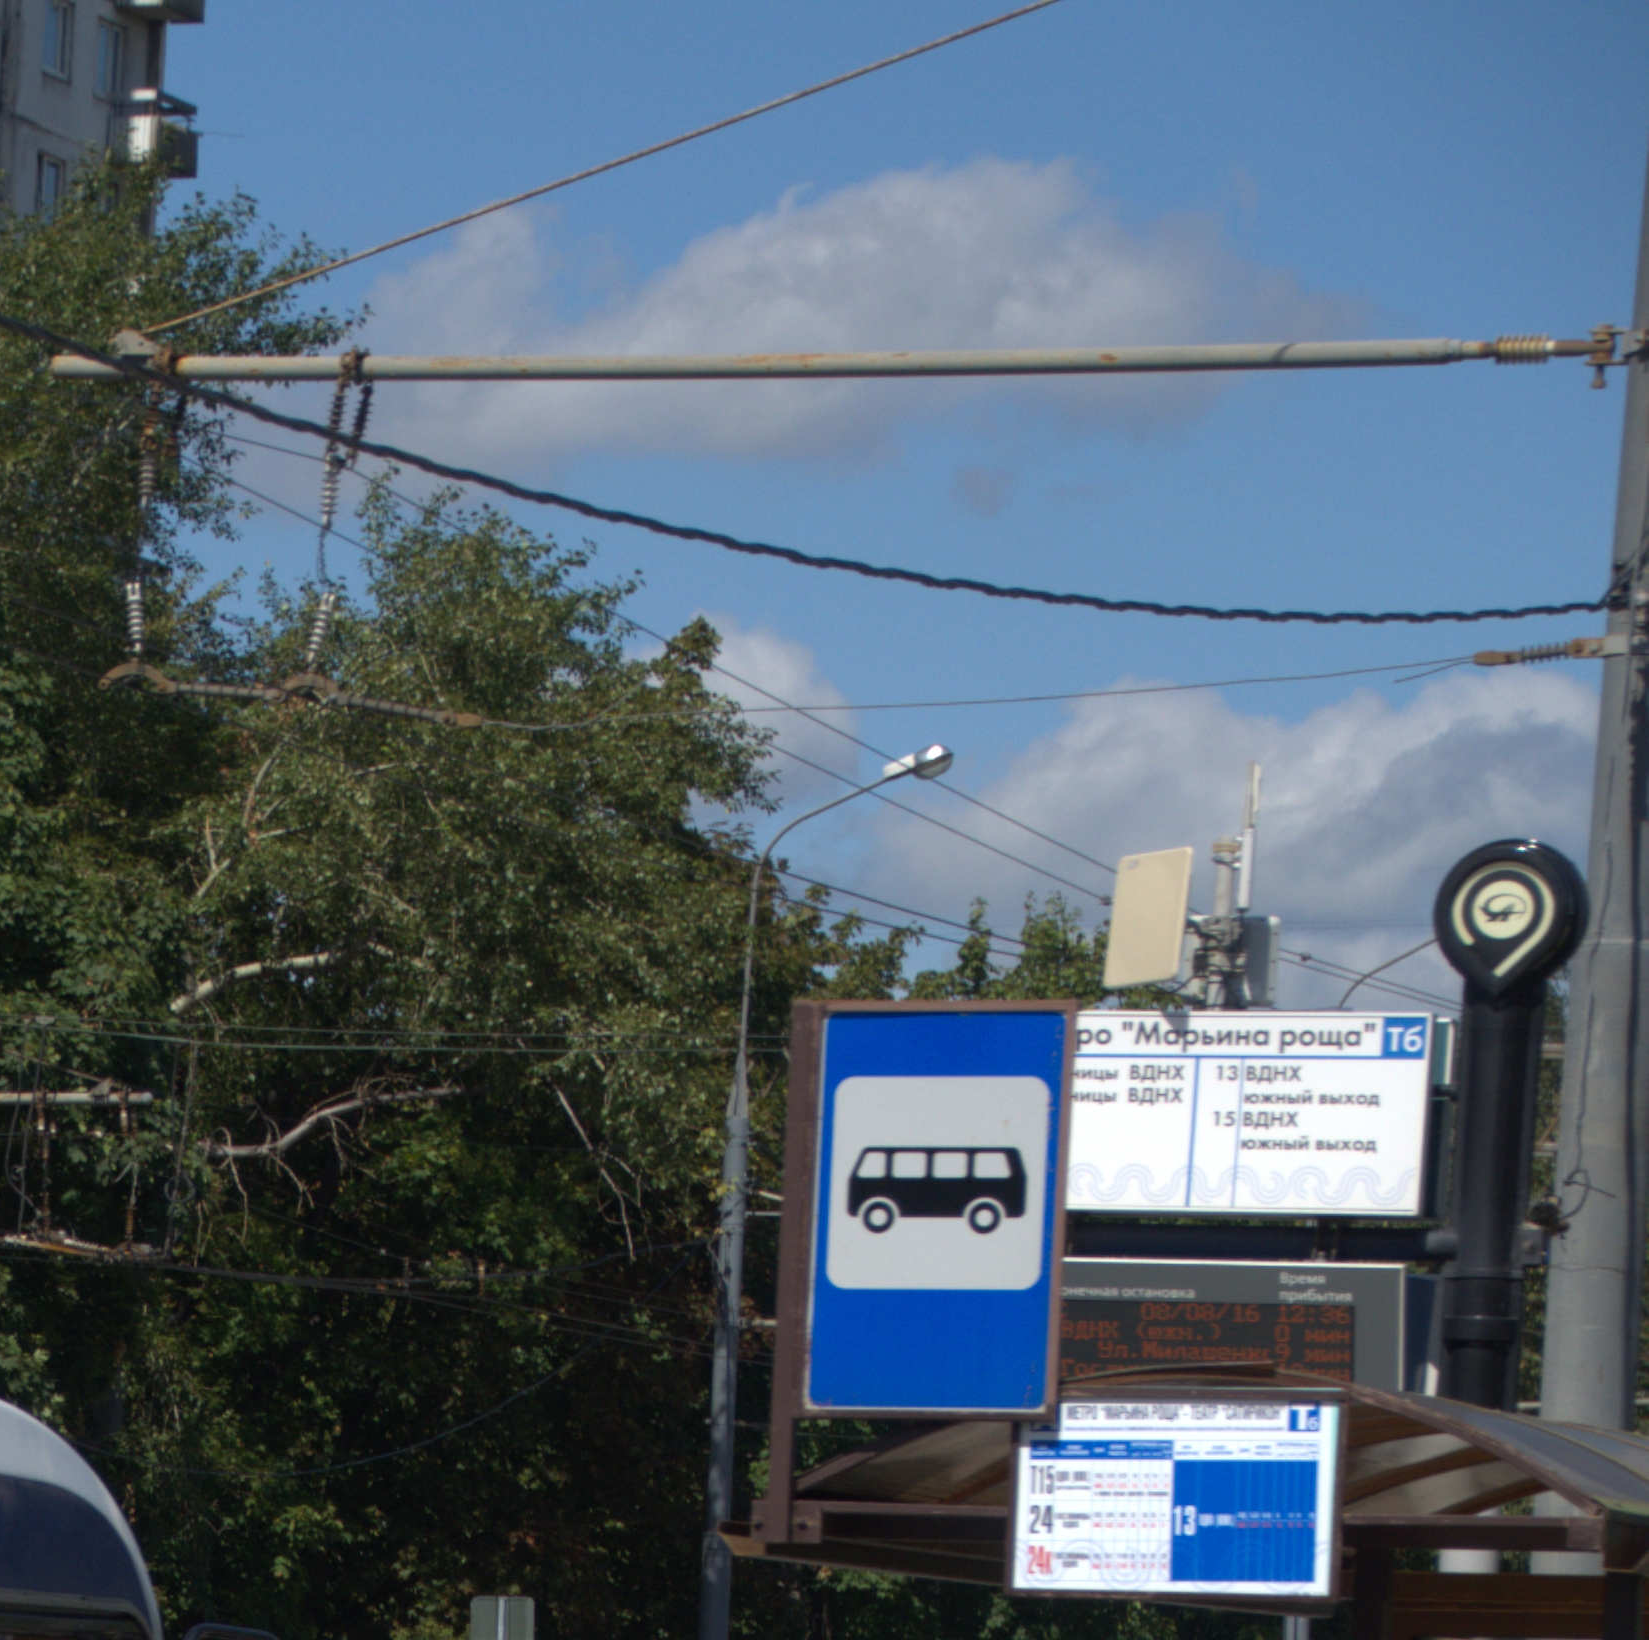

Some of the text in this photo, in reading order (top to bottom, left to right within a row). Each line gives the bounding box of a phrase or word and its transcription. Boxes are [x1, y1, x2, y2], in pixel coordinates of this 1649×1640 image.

[1122, 1021, 1269, 1053] "Марьина
[1278, 1023, 1377, 1054] роща"
[1129, 1064, 1186, 1083] ВДНХ
[1216, 1065, 1302, 1083] 13 ВДНХ
[1127, 1087, 1184, 1105] ВДНХ
[1243, 1089, 1381, 1107] южный выход
[1212, 1111, 1299, 1130] 15 ВДНХ
[1240, 1135, 1378, 1154] южный выход
[1279, 1271, 1326, 1286] Время
[1121, 1287, 1196, 1300] остановка
[1279, 1289, 1354, 1304] прибытия
[1140, 1302, 1261, 1322] 08/08/16
[1274, 1325, 1291, 1343] 0
[1304, 1329, 1351, 1344] мин
[1304, 1348, 1351, 1363] мин
[1029, 1504, 1053, 1534] 24
[1173, 1504, 1197, 1536] 13
